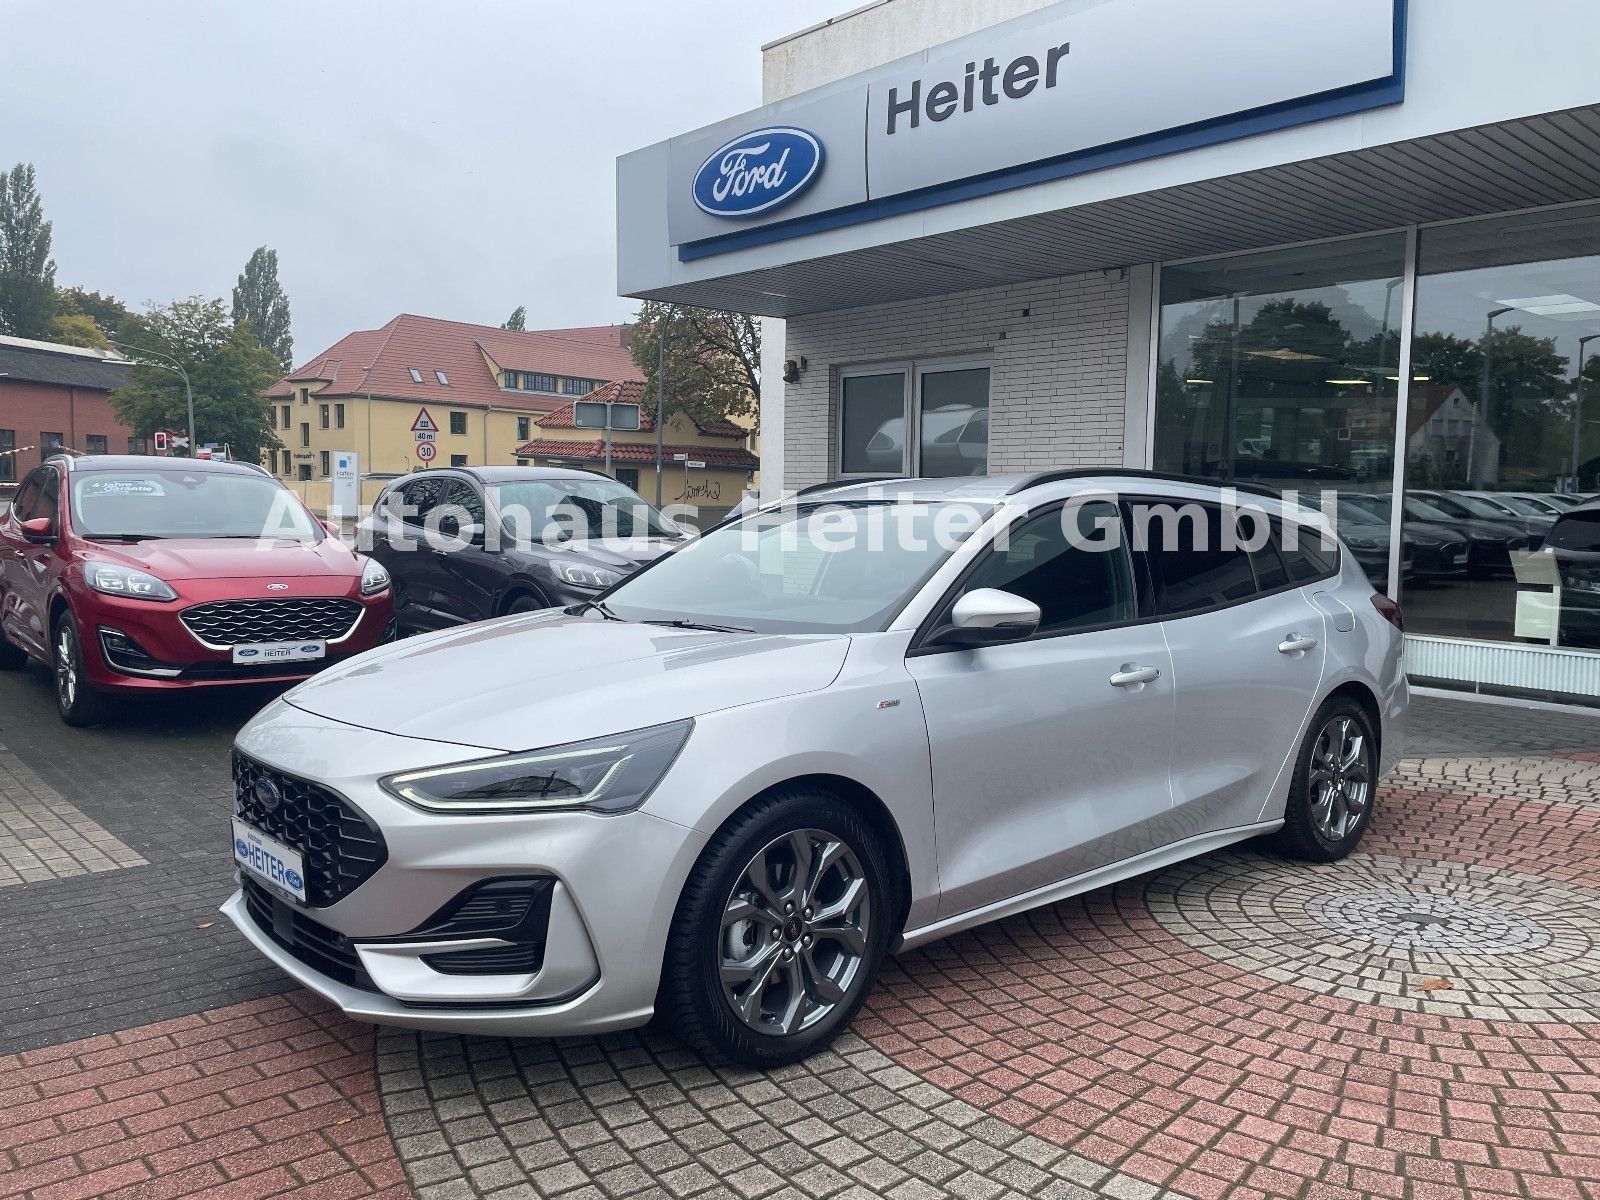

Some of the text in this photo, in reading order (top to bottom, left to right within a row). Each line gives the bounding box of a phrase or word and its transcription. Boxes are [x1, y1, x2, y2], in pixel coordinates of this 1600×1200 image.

[887, 42, 1070, 135] Heiter
[712, 141, 790, 202] Ford
[421, 447, 432, 457] 30
[248, 842, 286, 885] HEITER
